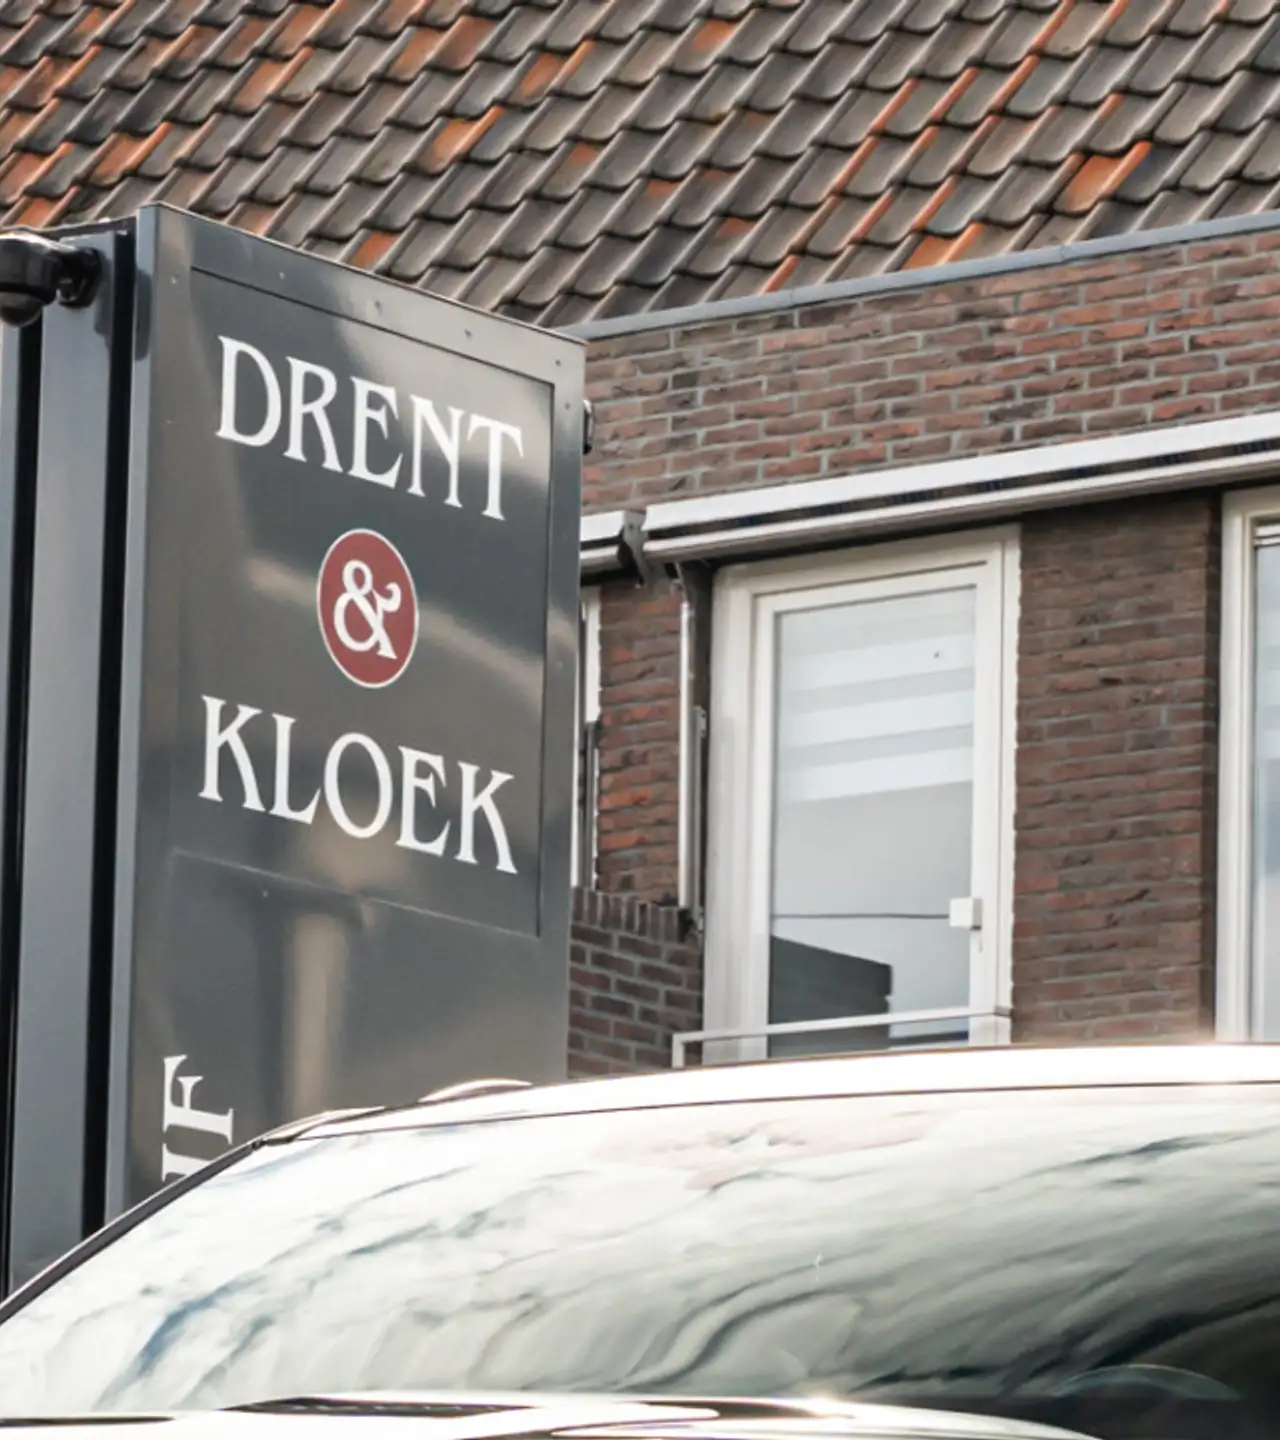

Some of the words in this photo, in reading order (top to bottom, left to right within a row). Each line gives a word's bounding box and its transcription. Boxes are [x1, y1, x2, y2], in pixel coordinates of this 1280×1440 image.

[215, 335, 524, 521] DRENT
[333, 559, 402, 660] &
[198, 695, 518, 874] KLOEK
